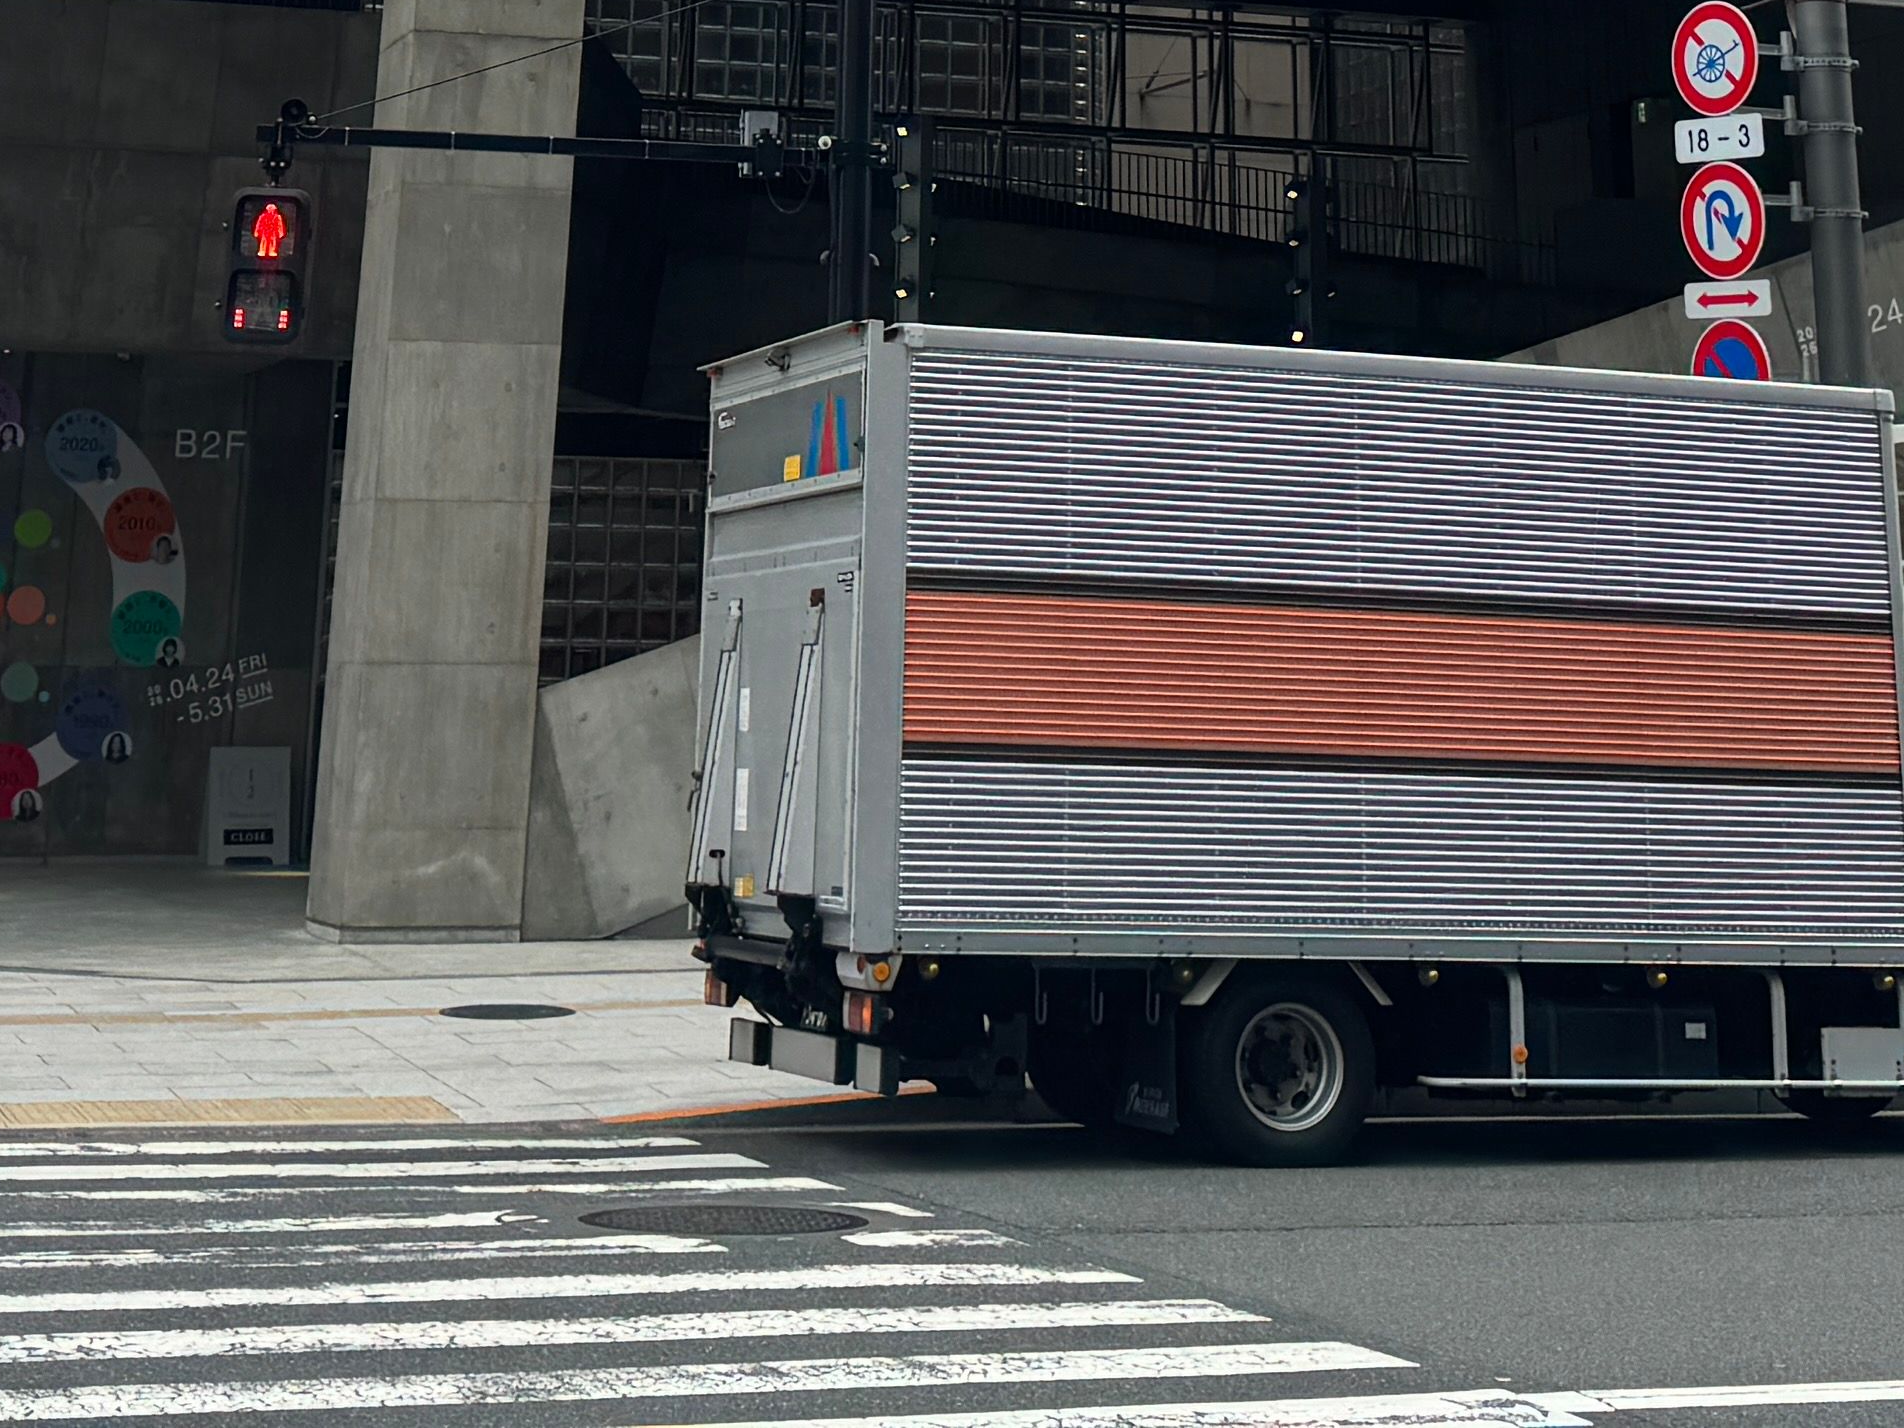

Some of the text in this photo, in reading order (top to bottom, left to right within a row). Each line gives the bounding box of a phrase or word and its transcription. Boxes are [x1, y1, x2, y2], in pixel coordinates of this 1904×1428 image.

[174, 428, 247, 460] B2F
[238, 652, 268, 674] FRI
[235, 680, 274, 704] SUN
